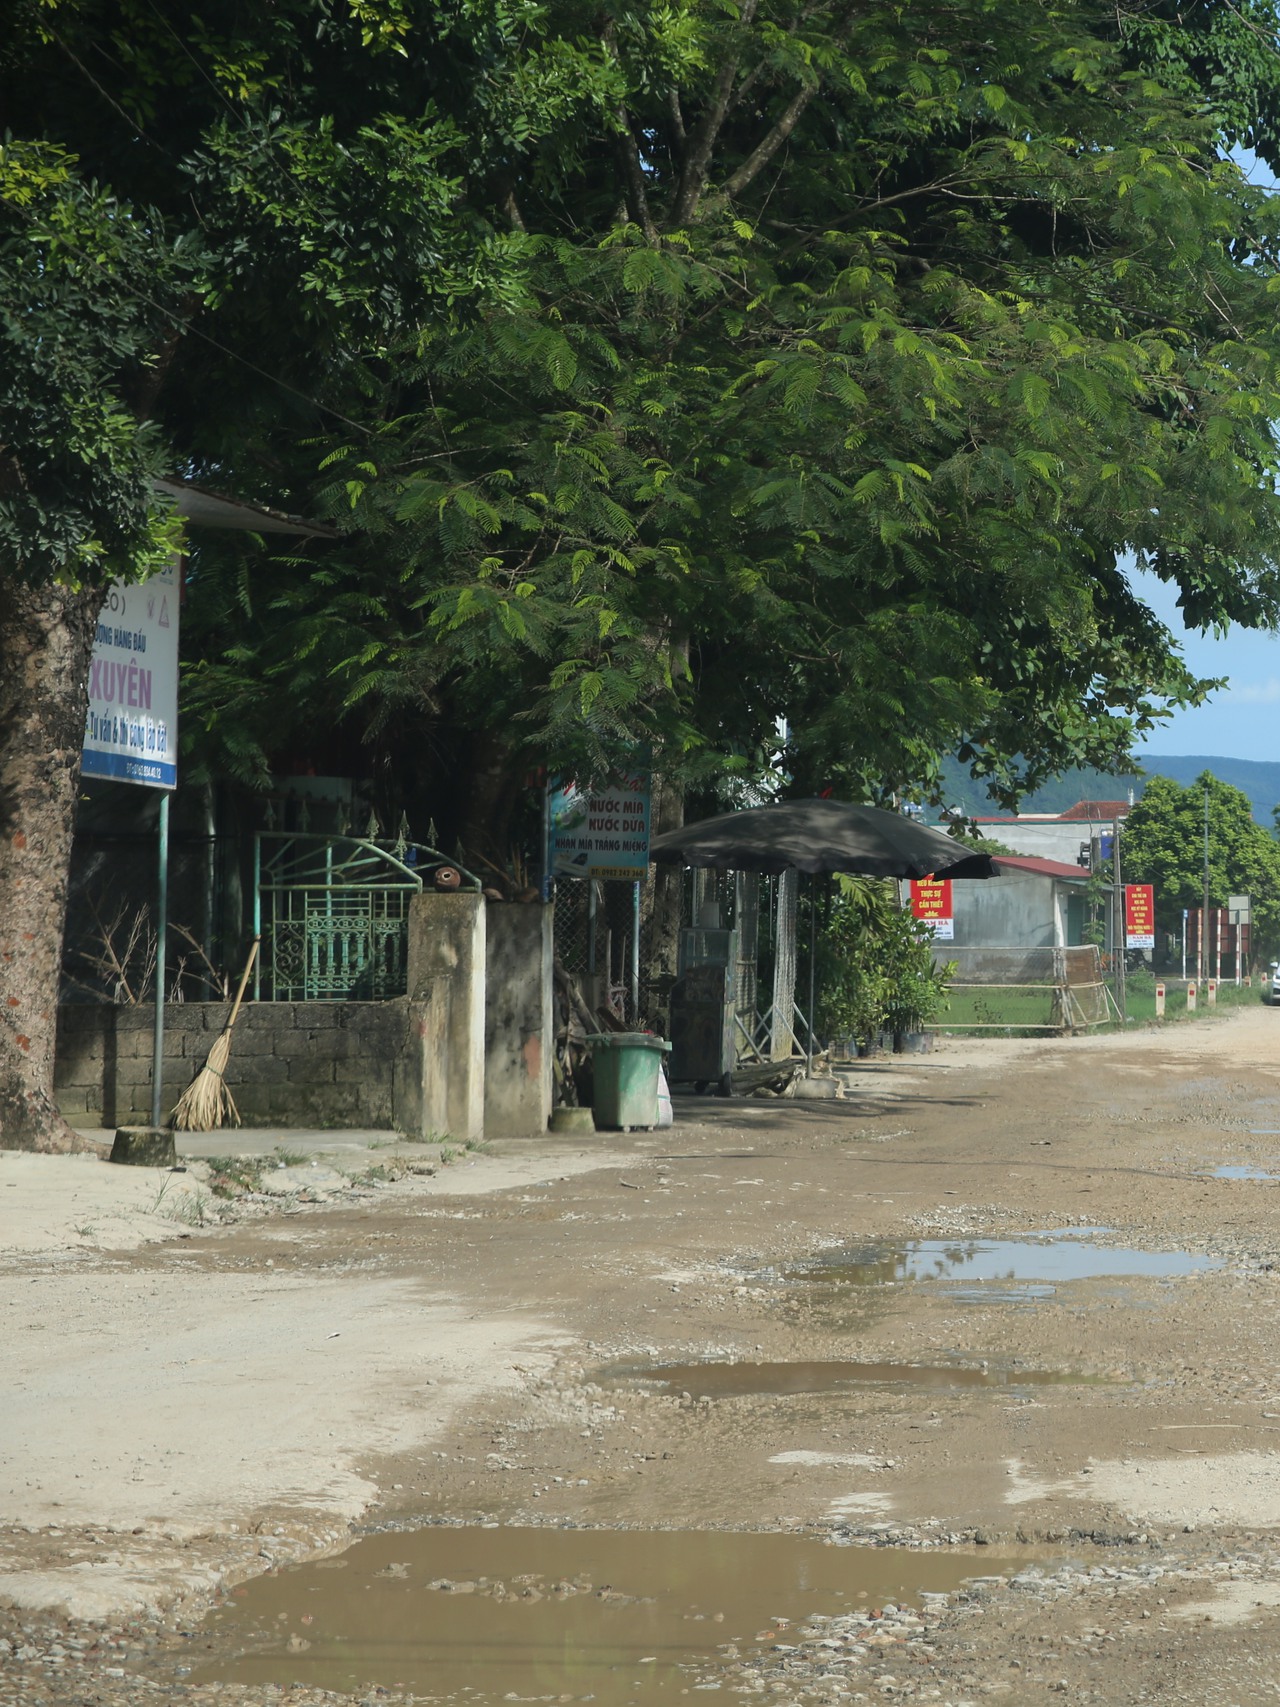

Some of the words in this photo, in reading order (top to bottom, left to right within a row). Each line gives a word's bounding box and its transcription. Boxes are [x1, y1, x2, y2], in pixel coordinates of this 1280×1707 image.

[90, 657, 152, 710] XUYÊN
[590, 796, 619, 813] NƯỚC
[623, 797, 643, 814] MÍA
[589, 814, 619, 831] NƯỚC
[623, 816, 645, 832] DỪA
